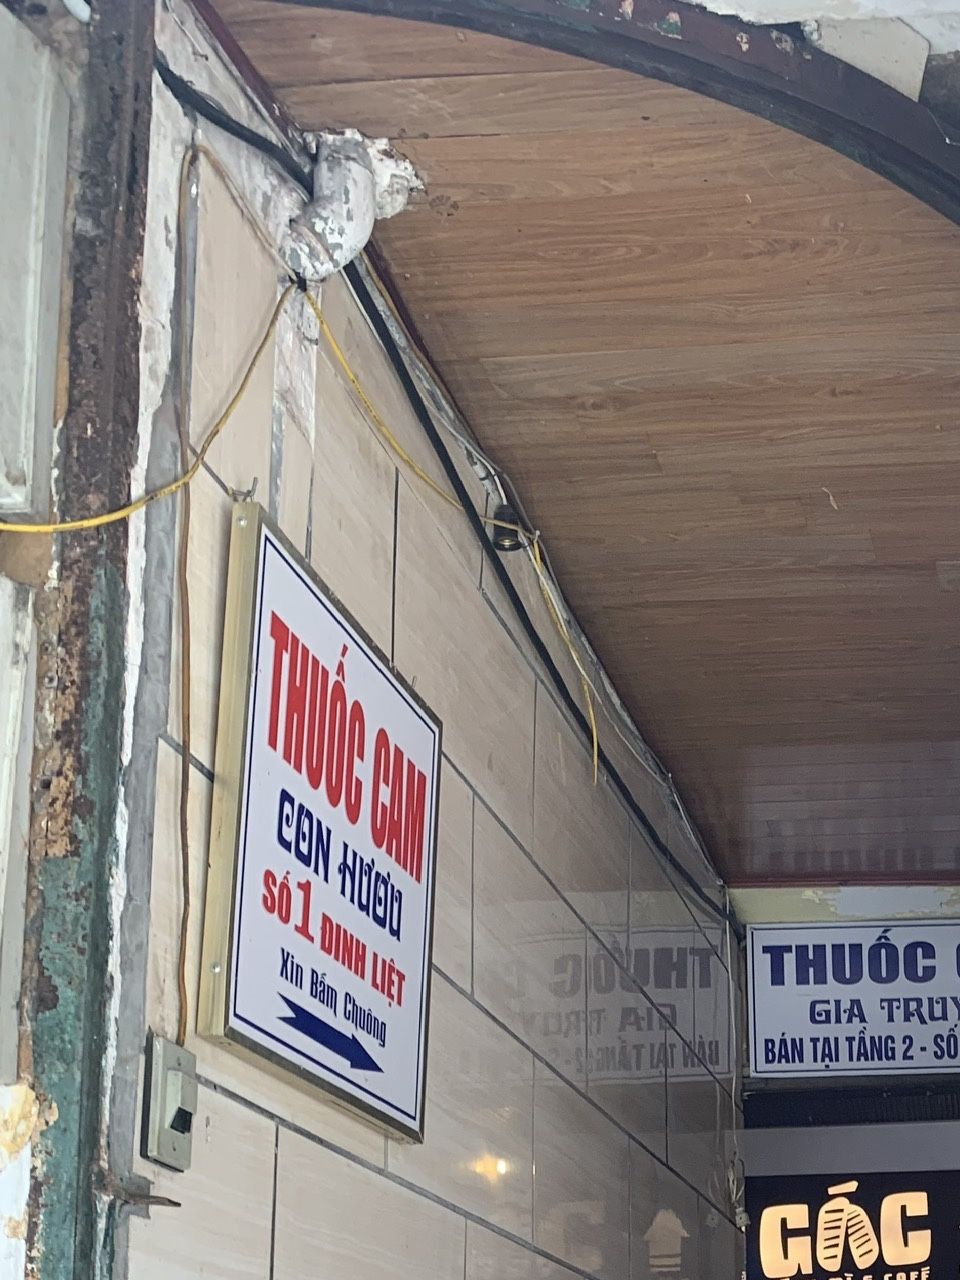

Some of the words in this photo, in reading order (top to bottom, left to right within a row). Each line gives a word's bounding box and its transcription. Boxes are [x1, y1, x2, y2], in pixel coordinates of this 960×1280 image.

[267, 609, 367, 827] THUỐC
[370, 727, 428, 886] CAM
[276, 787, 332, 885] CON
[261, 868, 293, 926] SỐ
[294, 878, 315, 945] 1
[371, 951, 406, 1008] LIỆT
[761, 928, 937, 987] THUỐC
[279, 946, 304, 991] Xin
[342, 990, 388, 1049] Chuông
[763, 1031, 805, 1065] BÁN
[809, 1035, 841, 1069] TẠI
[845, 1025, 897, 1063] TẦNG
[901, 1033, 915, 1062] 2
[932, 1023, 960, 1061] SỐ
[809, 998, 869, 1026] GIA
